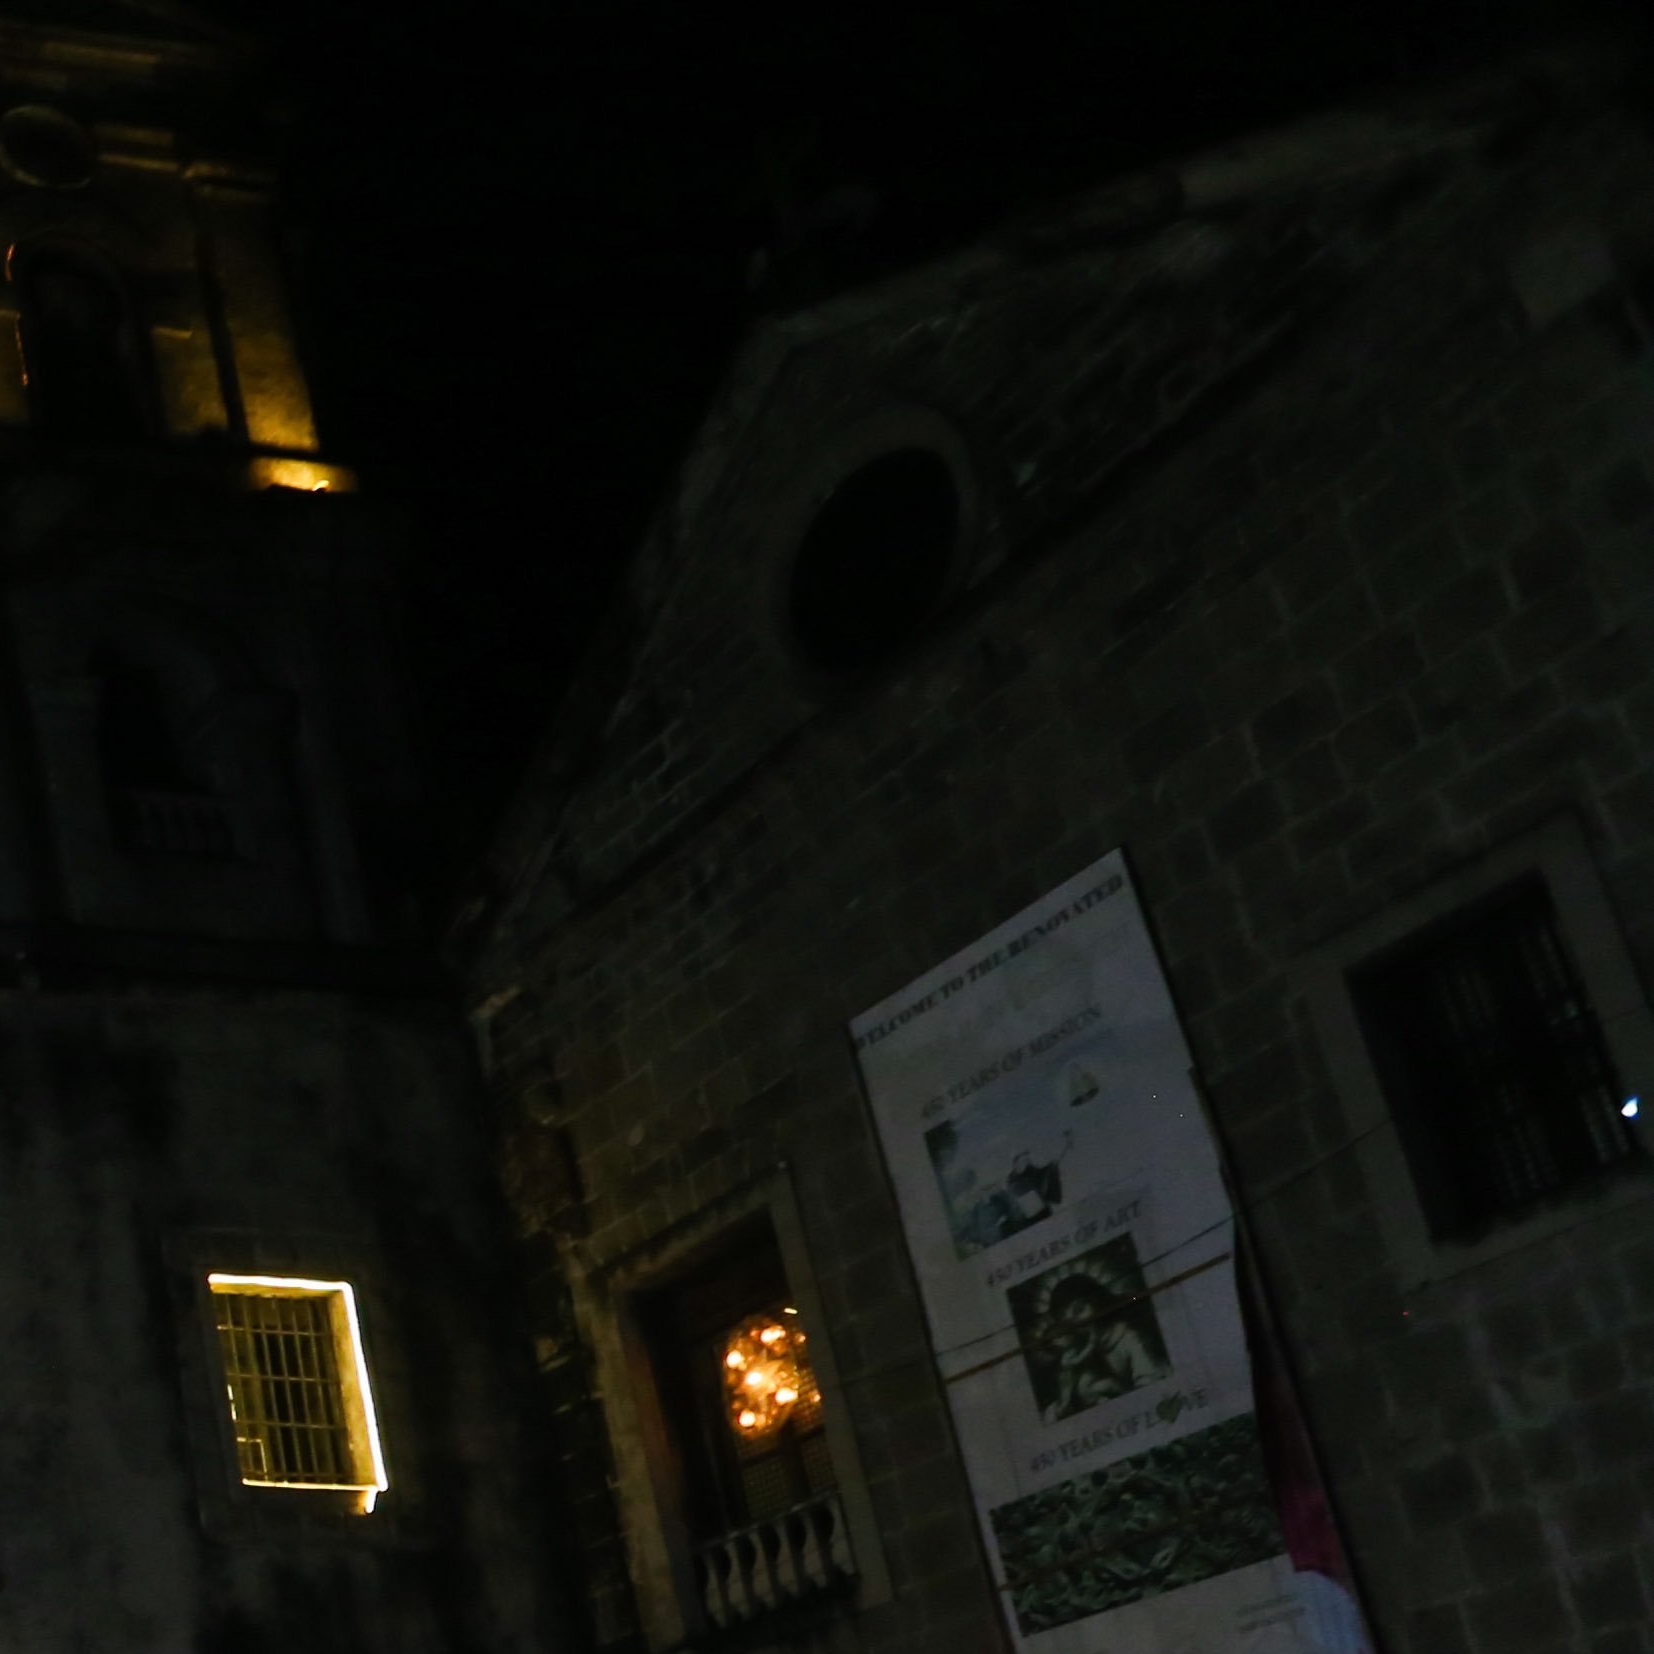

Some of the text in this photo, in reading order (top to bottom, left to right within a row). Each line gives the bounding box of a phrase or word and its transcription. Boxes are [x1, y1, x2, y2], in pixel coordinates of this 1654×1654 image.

[938, 976, 964, 999] TO
[966, 950, 1001, 983] THE
[1007, 874, 1123, 958] RENOVATED
[947, 1062, 999, 1103] YEARS
[1002, 1047, 1022, 1072] OF
[1028, 1004, 1101, 1056] MISSION
[1014, 1234, 1070, 1273] YEARS
[1075, 1220, 1098, 1244] OF
[1104, 1200, 1140, 1232] ART
[1059, 1428, 1113, 1462] YEARS
[1116, 1413, 1139, 1438] OF
